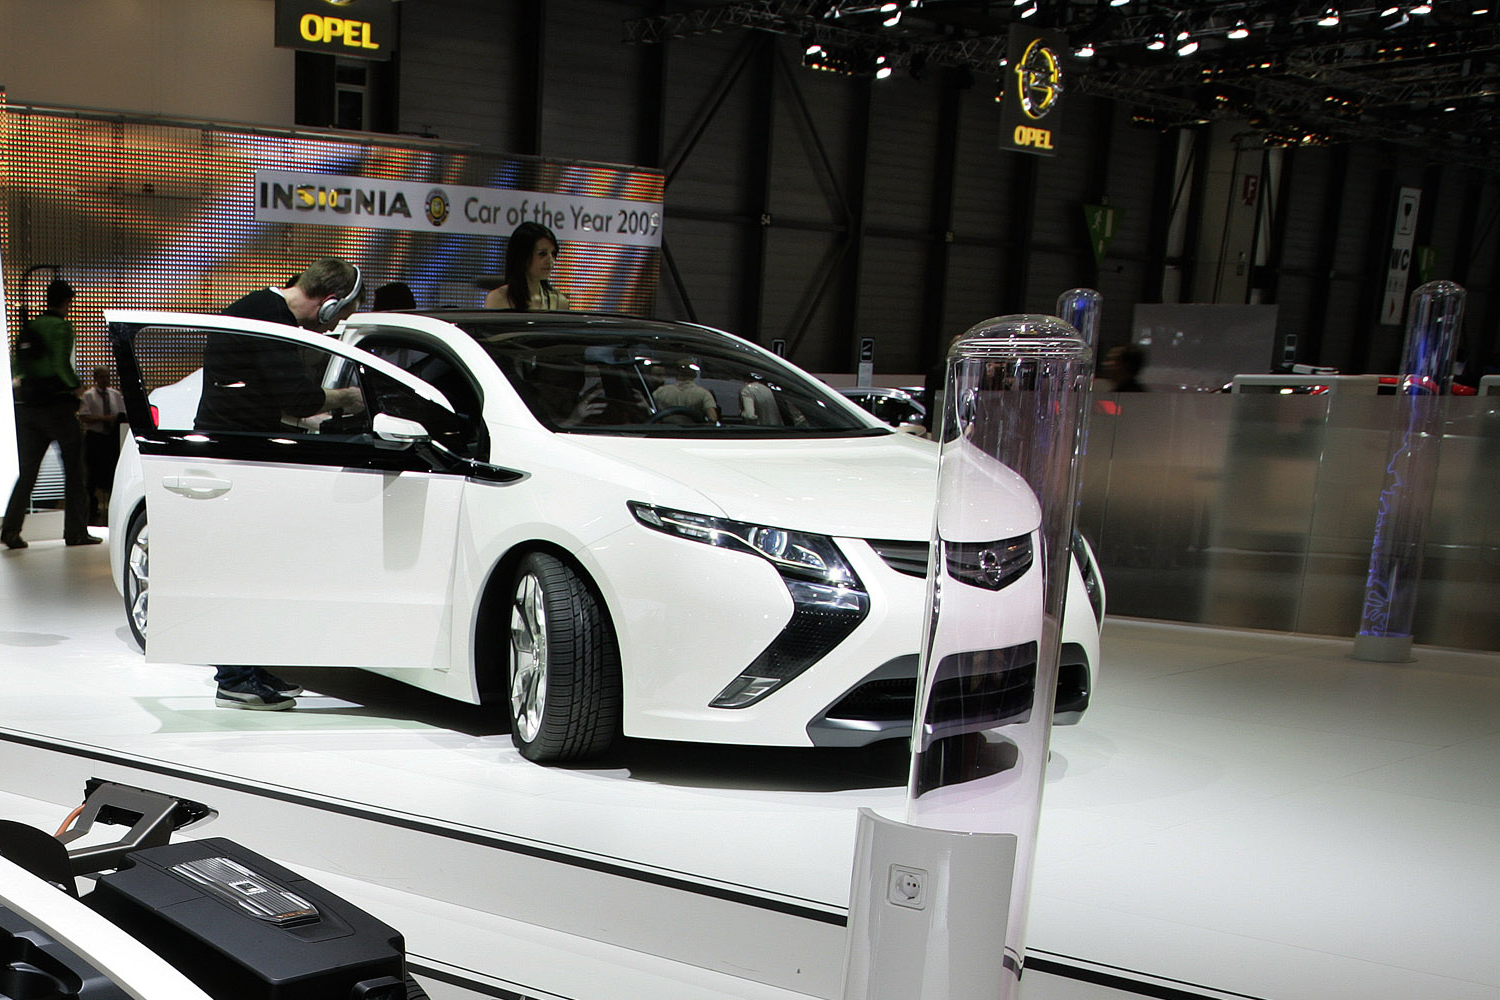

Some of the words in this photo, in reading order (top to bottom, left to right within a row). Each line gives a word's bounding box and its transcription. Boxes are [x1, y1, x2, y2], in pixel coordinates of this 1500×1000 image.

[299, 12, 381, 50] OPEL
[1014, 124, 1055, 150] OPEL
[260, 181, 412, 218] INSIGNIA
[464, 196, 501, 224] Car
[506, 199, 529, 226] of
[533, 201, 565, 230] the
[570, 204, 613, 233] Year
[617, 209, 661, 237] 2009
[1390, 248, 1410, 271] WC
